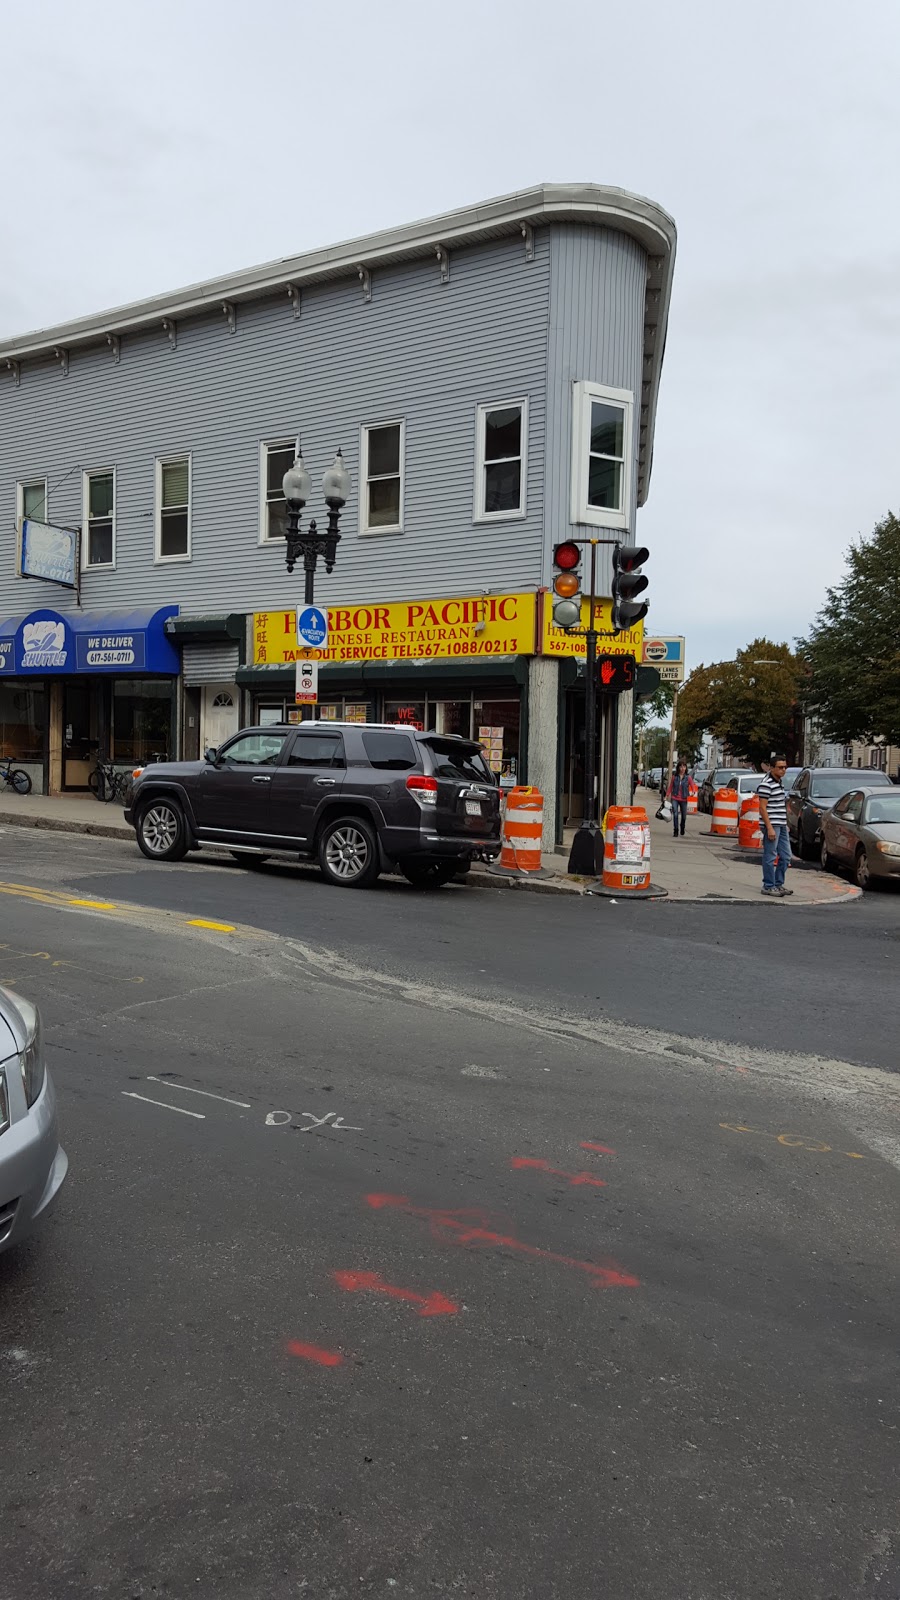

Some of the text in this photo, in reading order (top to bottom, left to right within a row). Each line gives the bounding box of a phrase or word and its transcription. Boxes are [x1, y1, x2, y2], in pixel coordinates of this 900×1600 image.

[28, 563, 71, 581] 561-0711
[284, 597, 518, 634] HRBOR PACIFIC
[256, 614, 269, 662] 好旺角
[301, 628, 325, 637] EVACUATION
[381, 626, 480, 644] RESTAURANT
[88, 637, 133, 648] WE DELIVER
[340, 646, 388, 659] SERVICE
[393, 638, 518, 657] TEL:567-1088/0213
[22, 651, 67, 667] SHUTTLE
[90, 652, 131, 663] 617-561-0711
[624, 661, 632, 682] 5
[397, 707, 416, 720] WE
